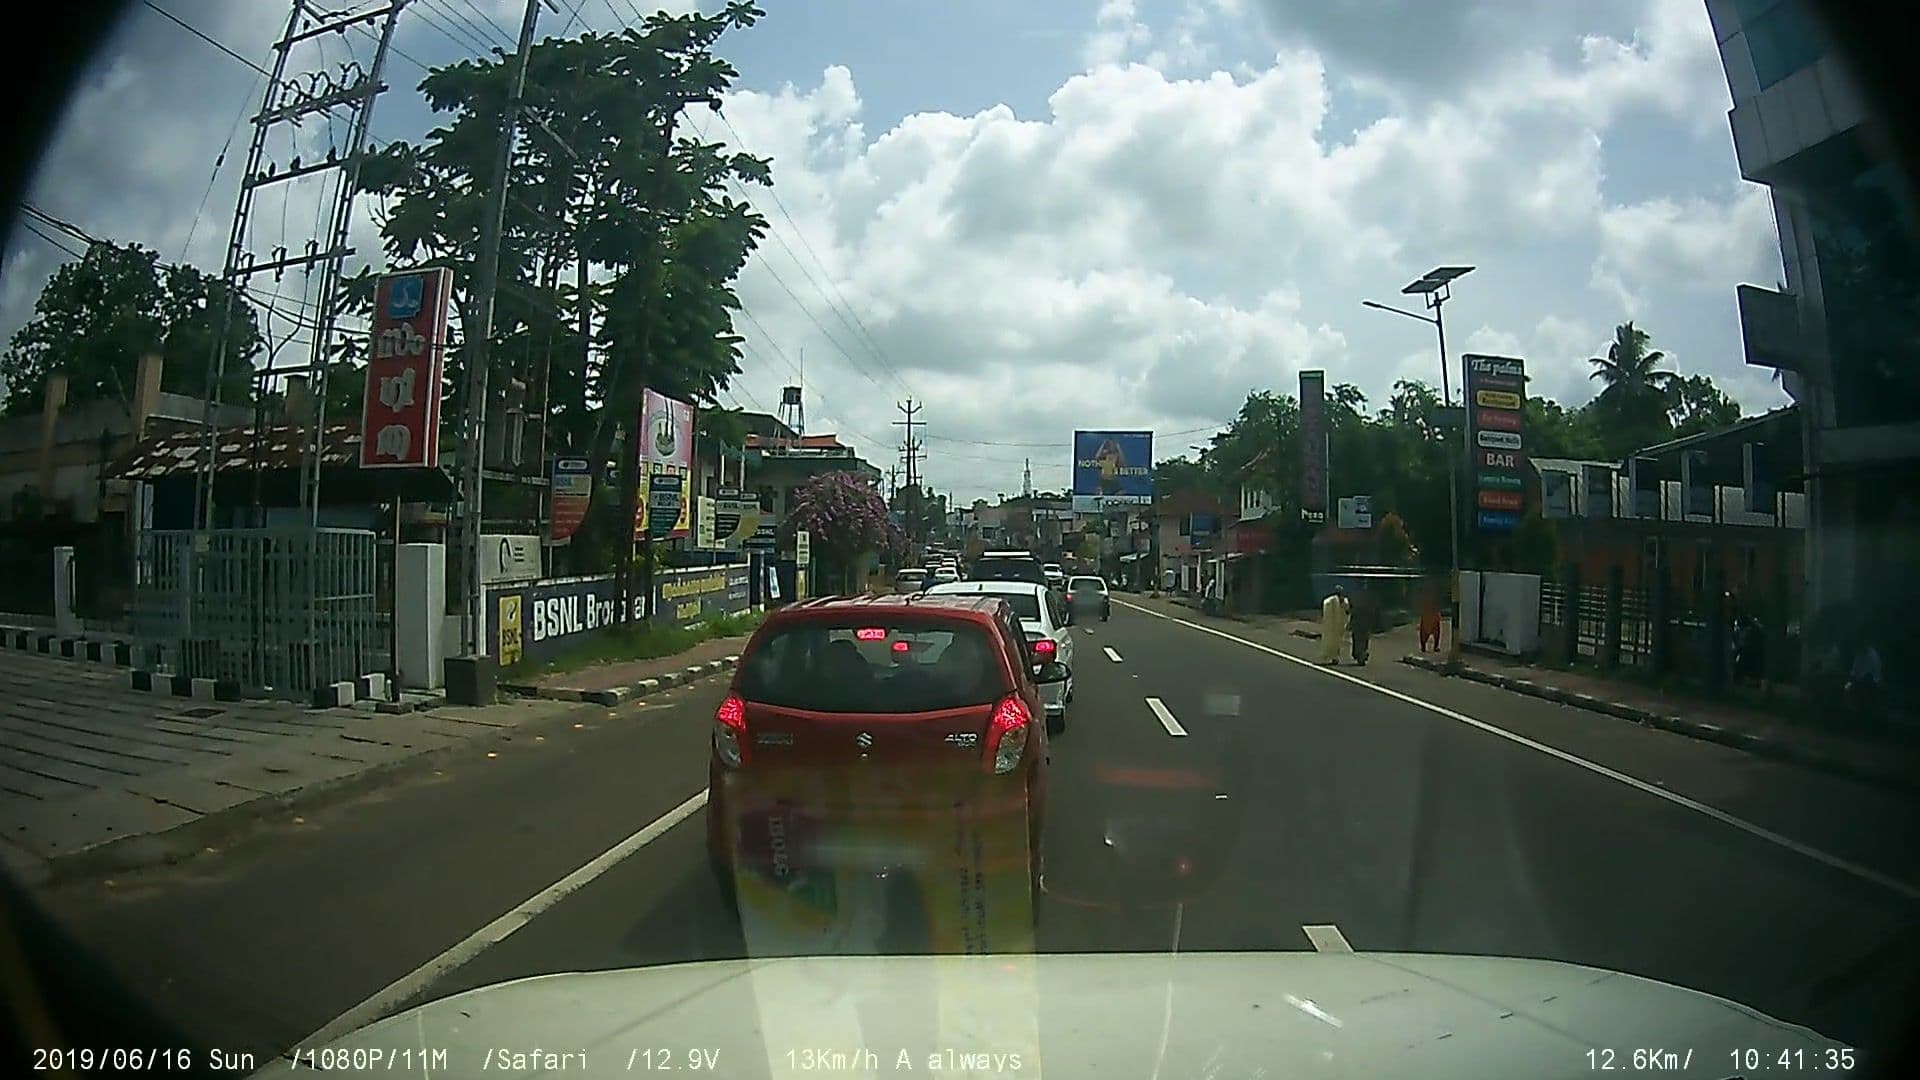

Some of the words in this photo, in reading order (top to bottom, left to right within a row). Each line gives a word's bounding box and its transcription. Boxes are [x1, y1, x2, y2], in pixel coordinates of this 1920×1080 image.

[1472, 359, 1491, 371] The
[1487, 453, 1514, 467] BAR
[534, 594, 584, 641] BSNL
[502, 627, 519, 647] BSNL
[944, 733, 978, 742] ALTO
